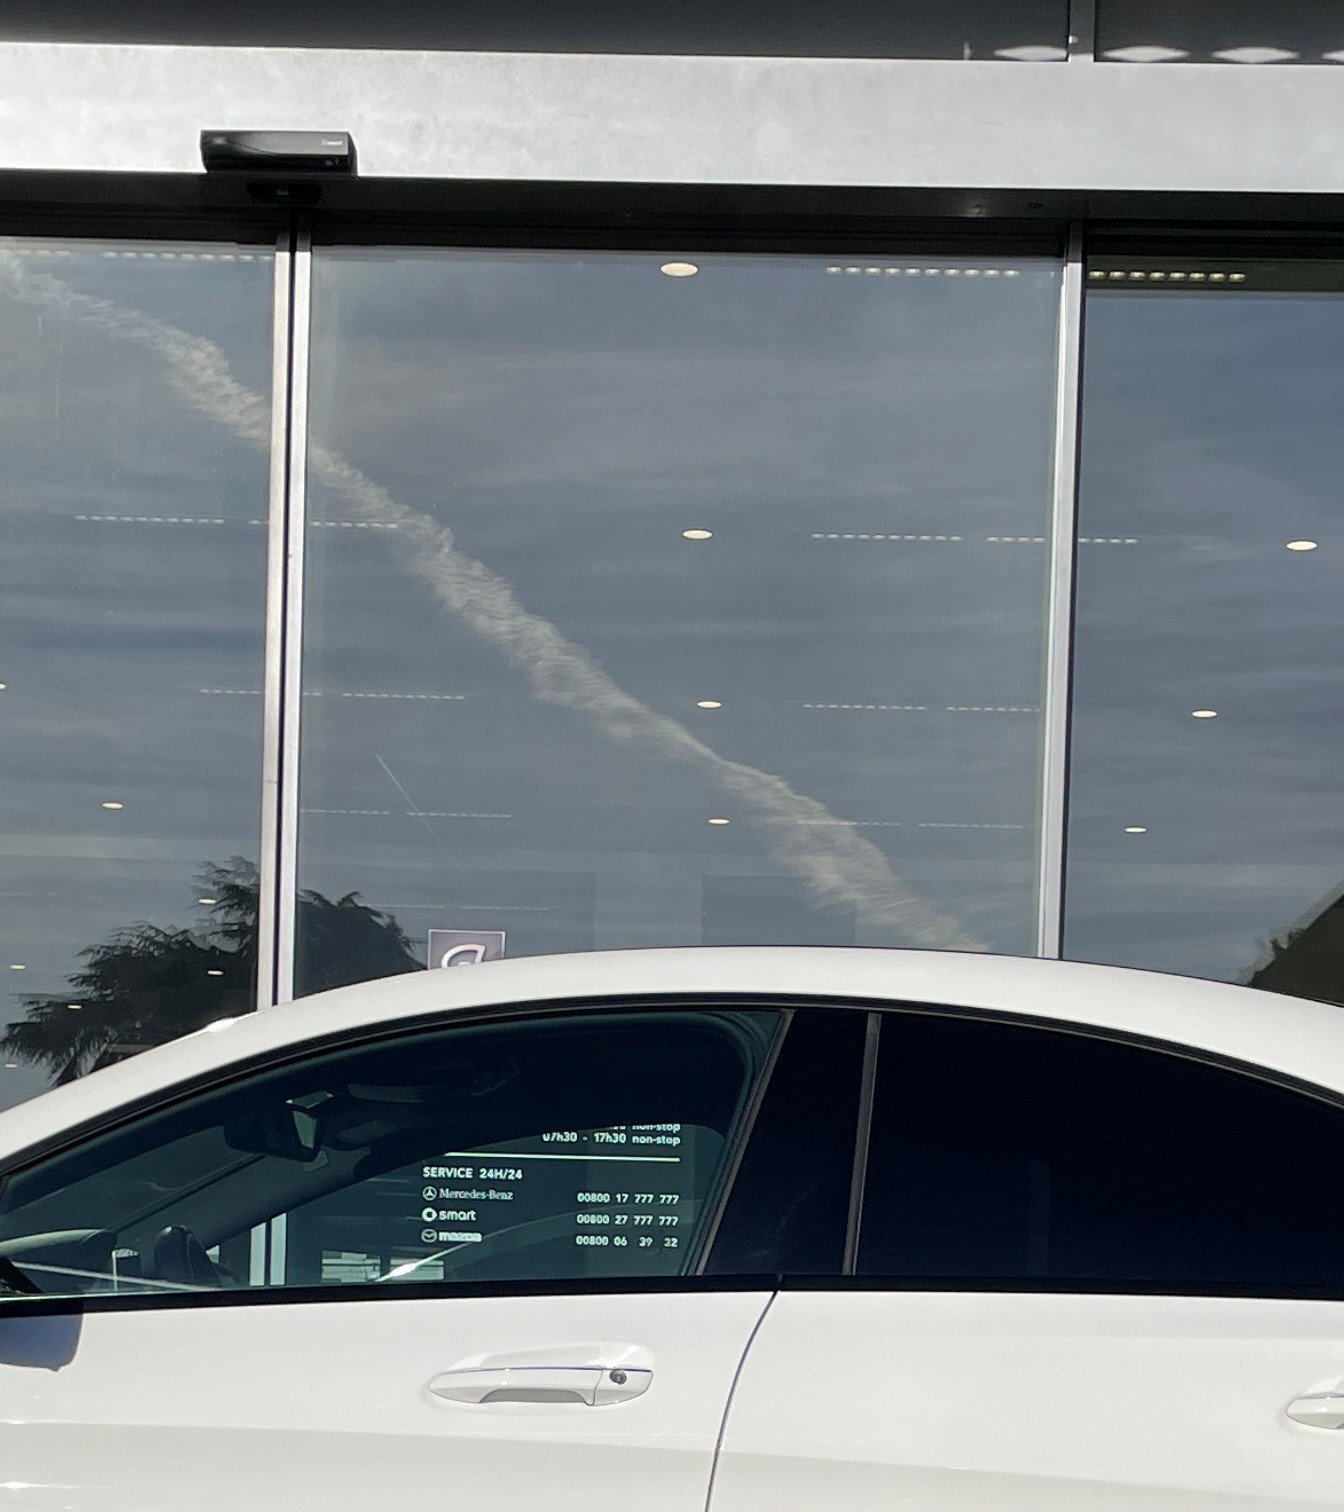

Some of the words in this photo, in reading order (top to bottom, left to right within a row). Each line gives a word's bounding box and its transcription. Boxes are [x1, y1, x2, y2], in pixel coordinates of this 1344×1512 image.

[594, 1132, 627, 1144] 17h30
[632, 1135, 681, 1147] non-stop
[422, 1166, 474, 1179] SERVICE
[479, 1167, 523, 1180] 24H/24
[438, 1188, 514, 1201] Mercedes-Benz
[577, 1192, 611, 1204] 00800
[616, 1193, 629, 1204] 17
[634, 1193, 655, 1205] 777
[659, 1194, 680, 1205] 777
[438, 1210, 477, 1221] smart
[576, 1213, 610, 1225] 00800
[614, 1214, 629, 1225] 27
[633, 1214, 654, 1226] 777
[658, 1215, 679, 1227] 777
[576, 1235, 609, 1246] 00800
[613, 1236, 628, 1247] 06
